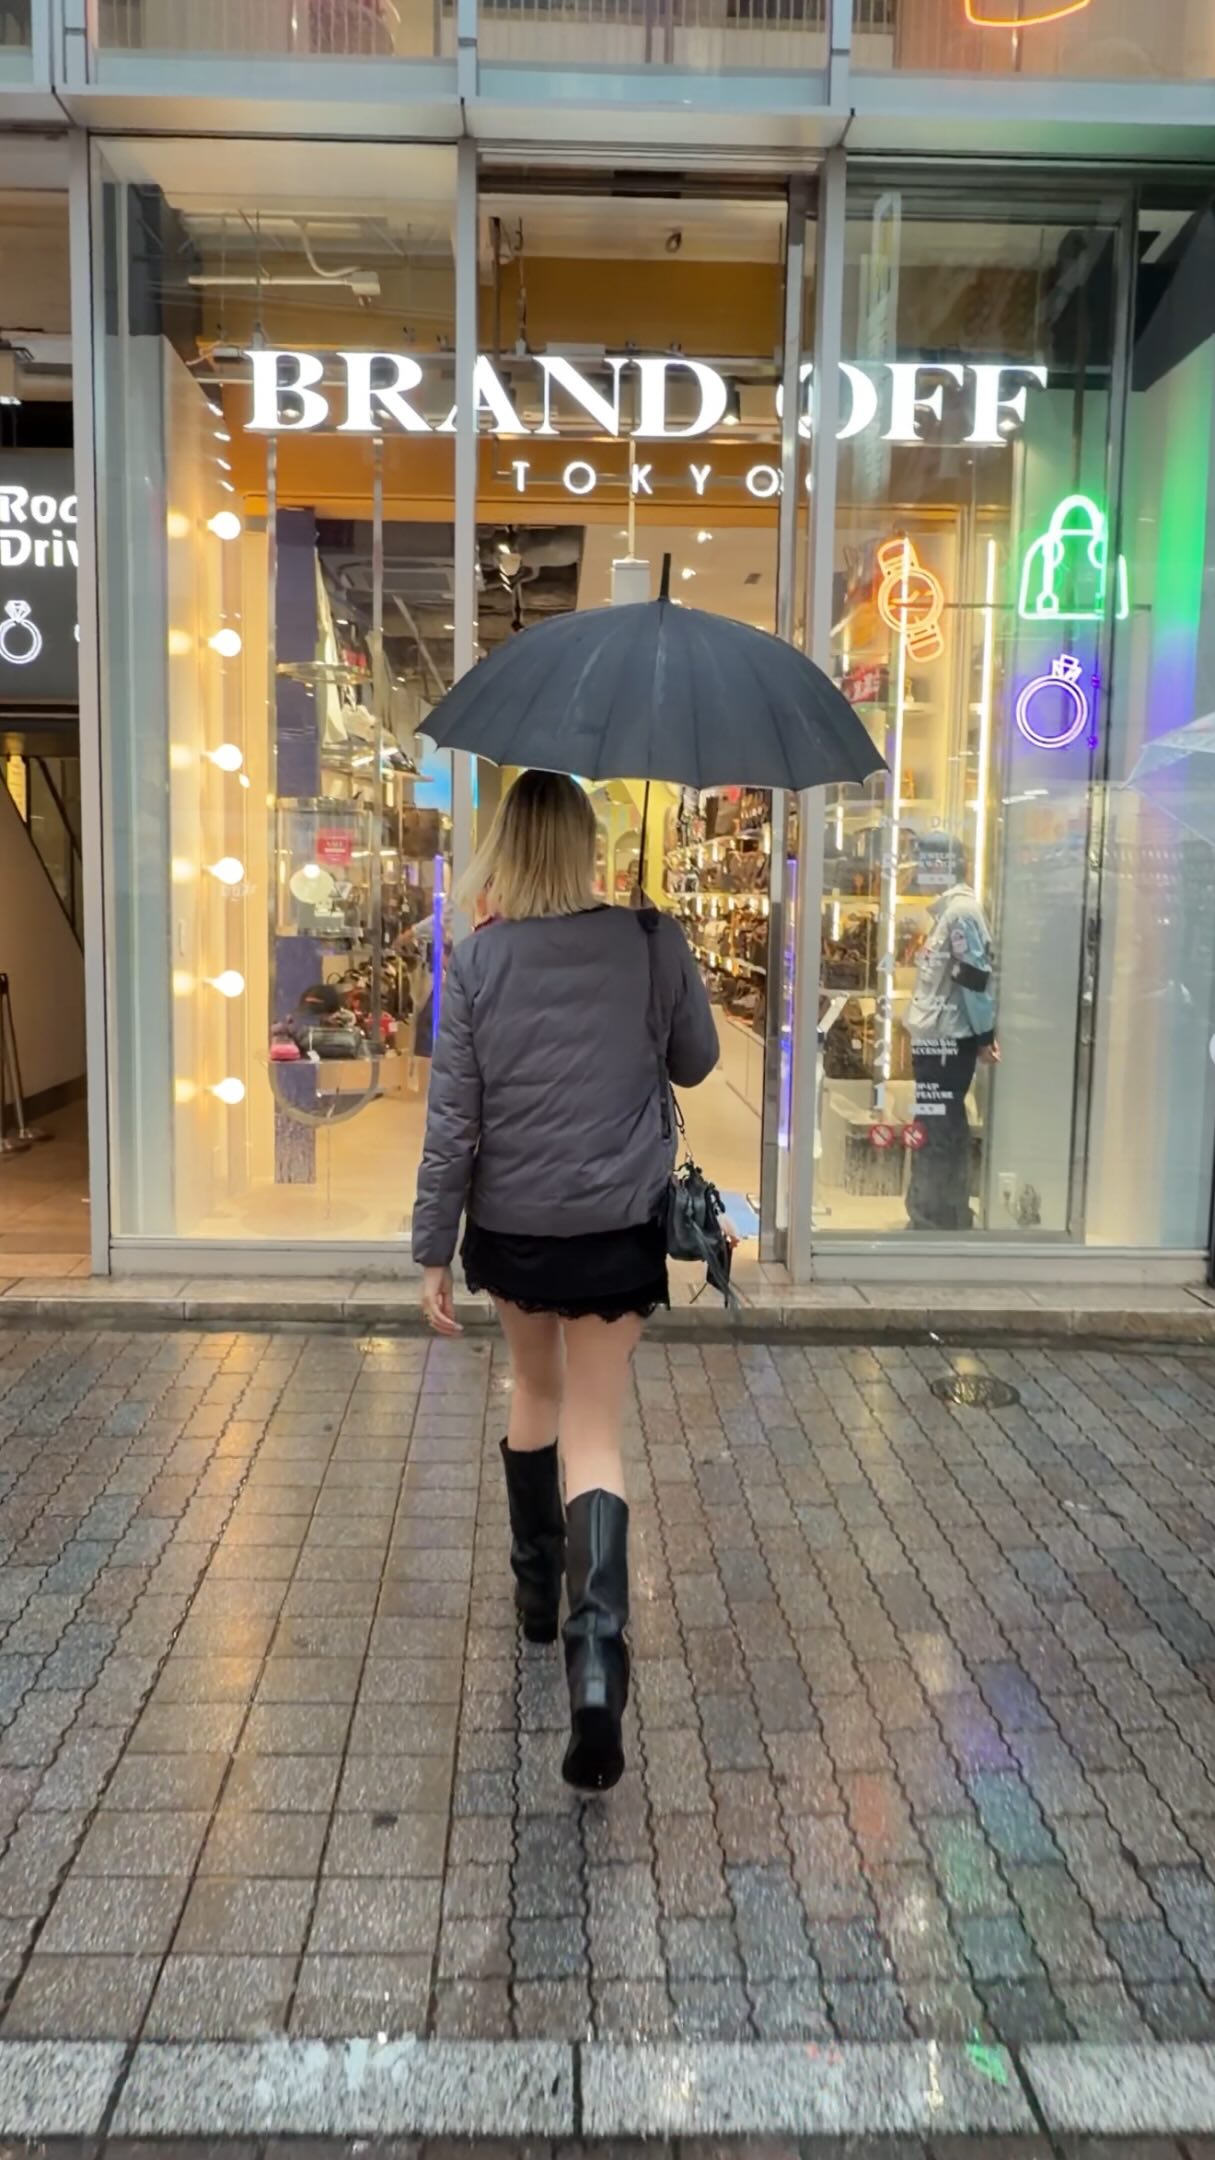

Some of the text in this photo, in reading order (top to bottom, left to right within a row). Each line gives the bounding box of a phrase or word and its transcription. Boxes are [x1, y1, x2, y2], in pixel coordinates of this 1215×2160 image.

[243, 350, 1048, 443] BRAND OFF
[511, 460, 779, 497] TOKYO
[873, 1083, 886, 1110] 1
